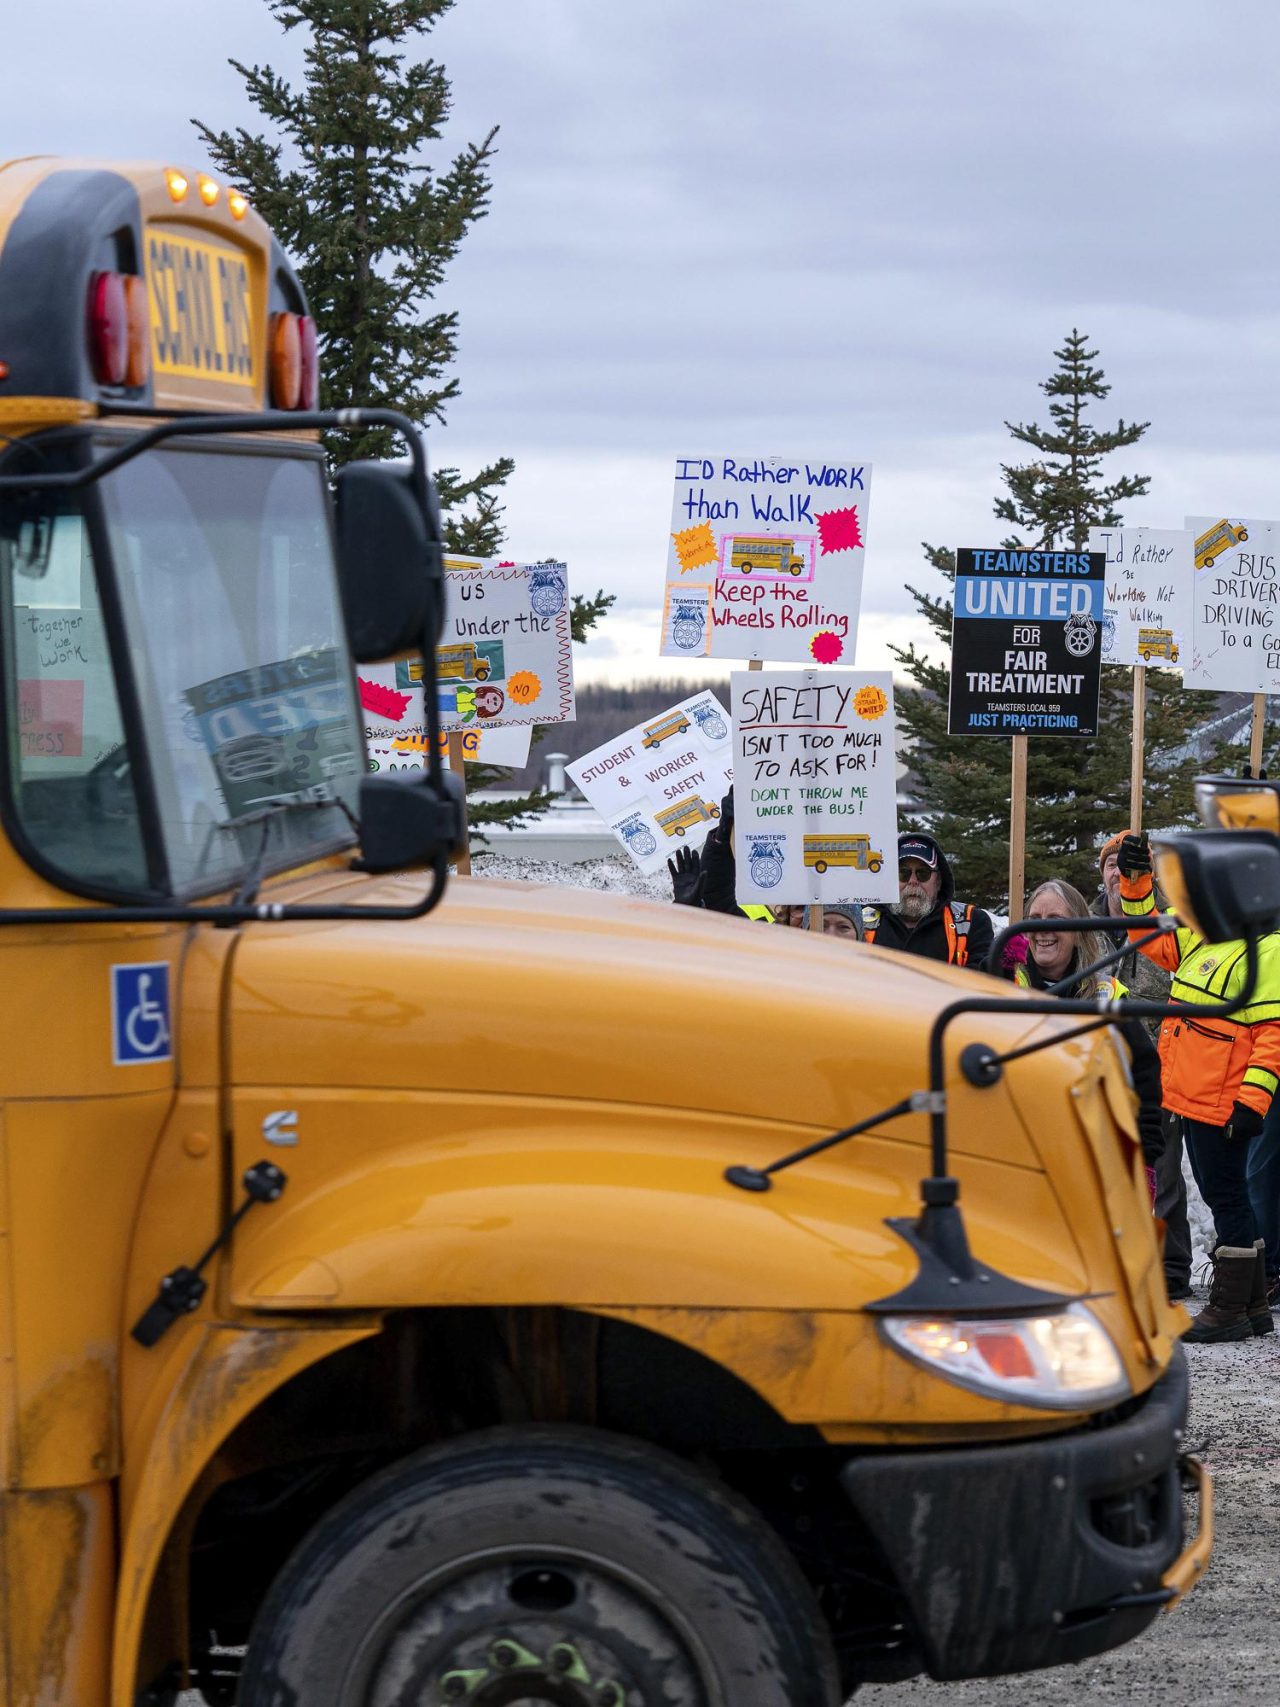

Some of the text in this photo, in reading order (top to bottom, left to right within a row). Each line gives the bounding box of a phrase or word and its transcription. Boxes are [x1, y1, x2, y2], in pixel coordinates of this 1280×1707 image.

[150, 239, 252, 378] SCHOOL BUS
[723, 459, 799, 483] Rather
[805, 464, 864, 490] WORK
[682, 488, 738, 519] than
[972, 551, 1090, 574] TEAMSTERS
[1132, 545, 1173, 564] Rather
[525, 562, 567, 571] TEAMSTERS
[1232, 553, 1276, 581] BUS
[461, 584, 485, 600] US
[672, 598, 709, 606] TEAMSTERS
[714, 578, 809, 605] Keep the
[964, 580, 1093, 616] UNITED
[1157, 585, 1175, 602] Not
[456, 612, 550, 636] Under the
[712, 605, 849, 638] Wheels Rolling
[1201, 604, 1273, 628] DRIVING
[55, 638, 71, 649] we
[1013, 628, 1041, 644] FOR
[1004, 651, 1047, 671] FAIR
[513, 684, 529, 697] NO
[966, 672, 1084, 694] TREATMENT
[684, 698, 712, 714] TEAMSTERS
[739, 685, 851, 723] SAFETY
[987, 703, 1026, 711] TEAMSTERS
[1027, 704, 1047, 712] LOCAL
[968, 714, 1078, 728] JUST PRACTICING
[742, 733, 882, 757] ISN'T TOO MUCH
[581, 745, 637, 784] STUDENT
[618, 750, 699, 788] & WORKER
[754, 760, 781, 781] TO
[789, 759, 828, 777] ASK
[663, 771, 706, 800] SAFETY
[751, 786, 868, 802] DON'T THROW ME
[611, 811, 642, 831] TEAMSTERS
[756, 804, 794, 817] UNDER
[804, 804, 823, 816] THE
[745, 834, 787, 842] TEAMSTERS
